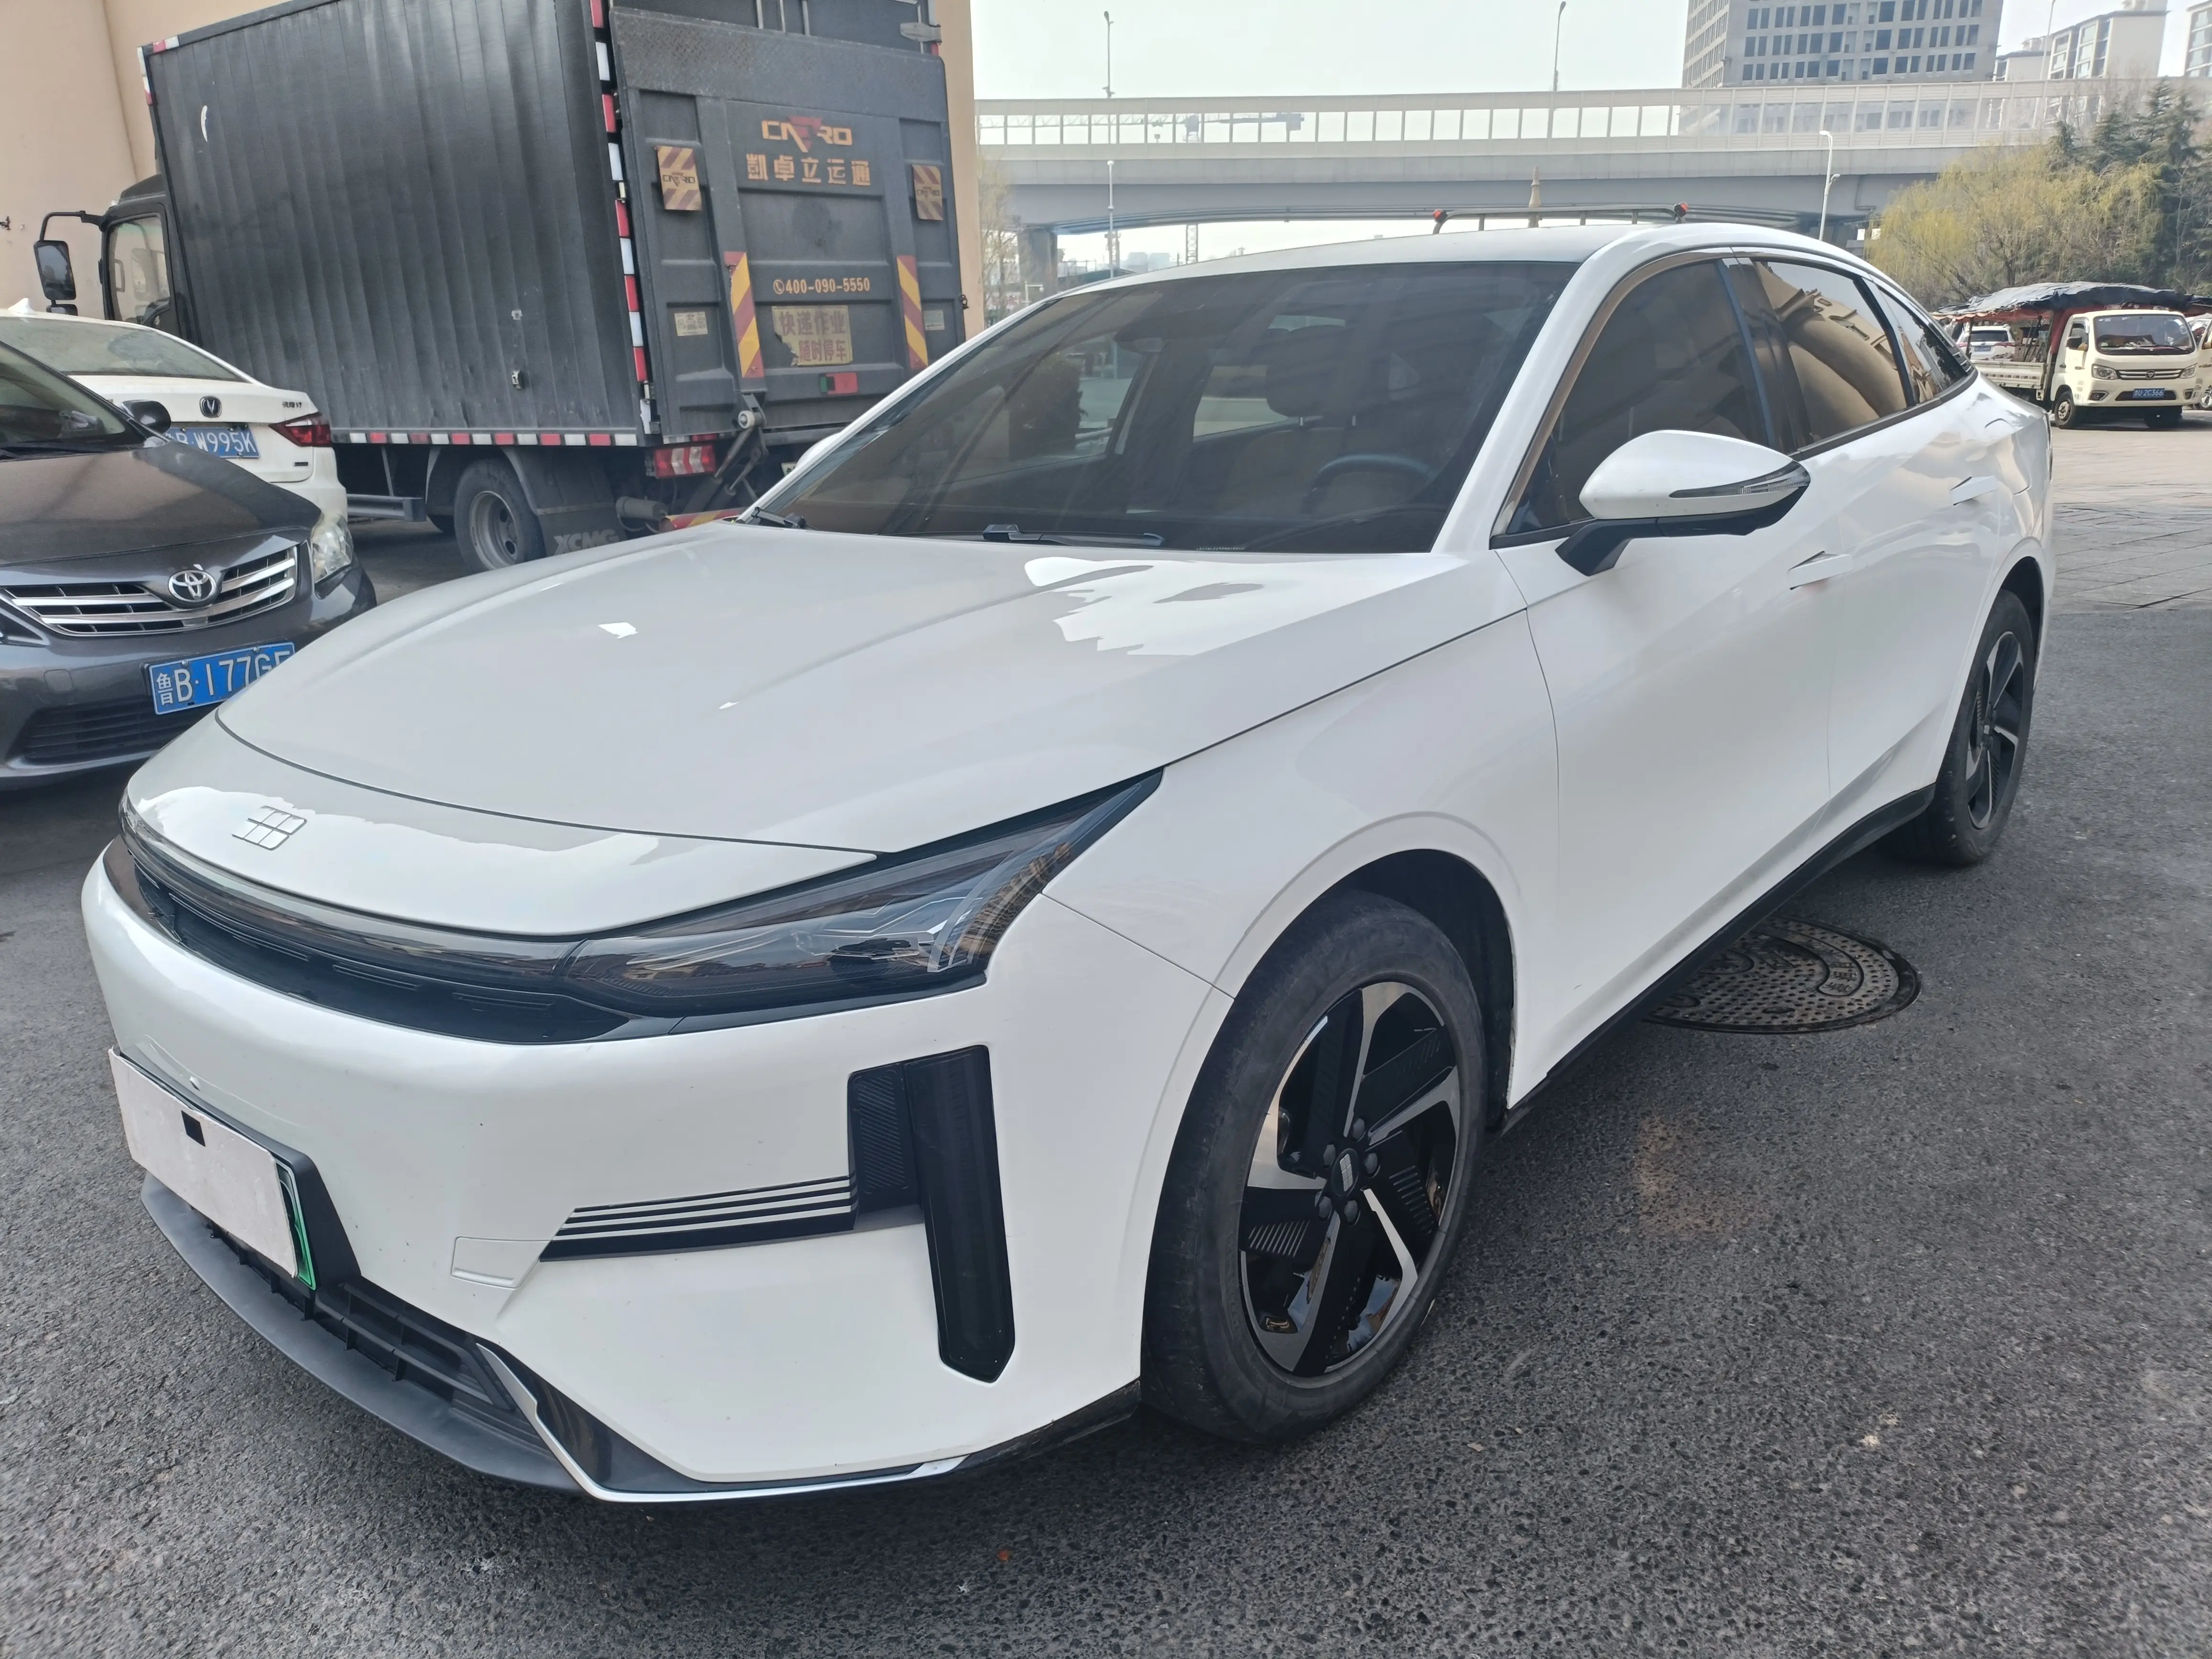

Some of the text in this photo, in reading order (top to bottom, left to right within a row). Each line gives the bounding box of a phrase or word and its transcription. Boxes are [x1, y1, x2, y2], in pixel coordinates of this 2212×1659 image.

[746, 154, 870, 185] 凯卓立运通
[785, 277, 870, 294] 400-090-5550
[779, 310, 846, 335] 快递作业
[798, 339, 846, 362] 随时停车
[166, 432, 256, 453] B·W995K
